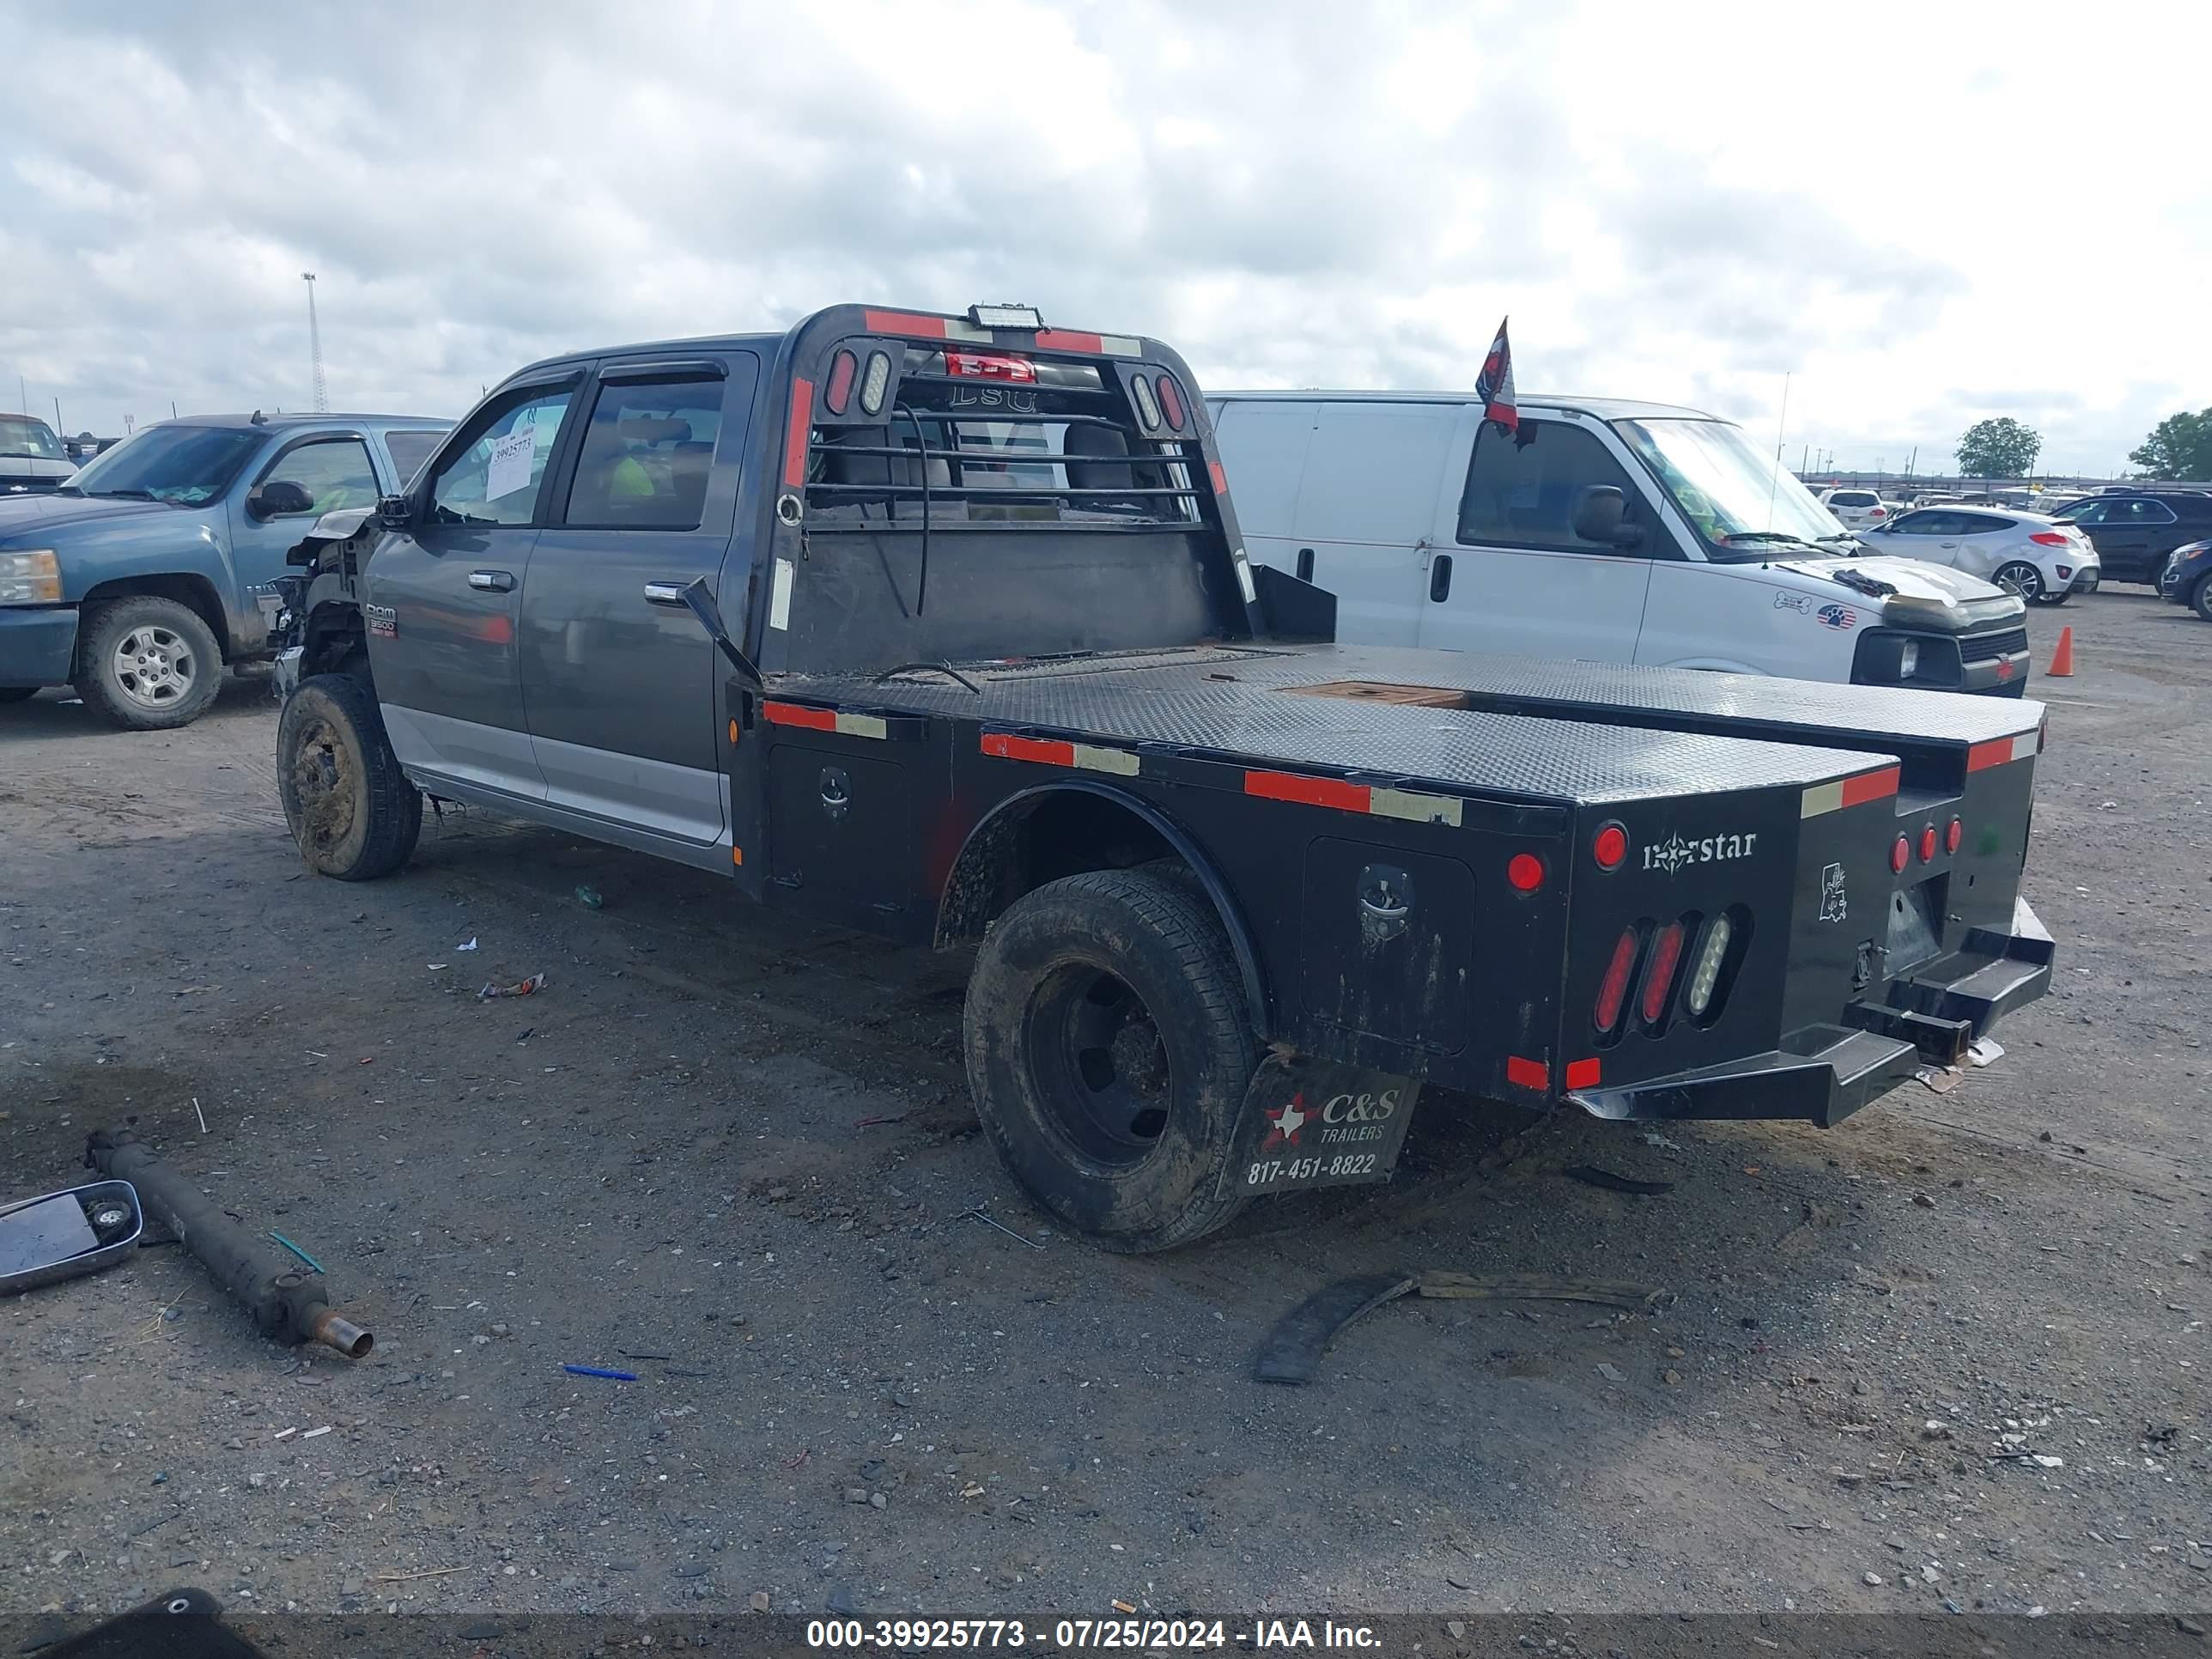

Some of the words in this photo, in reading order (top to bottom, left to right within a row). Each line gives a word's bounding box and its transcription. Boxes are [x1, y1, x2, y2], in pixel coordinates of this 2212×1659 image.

[950, 386, 1038, 413] LSU
[494, 437, 532, 463] 39925773
[370, 618, 395, 630] 3500
[1322, 1089, 1400, 1124] C&S
[1321, 1125, 1384, 1143] TRAILERS
[1248, 1153, 1376, 1185] 817-451-8822
